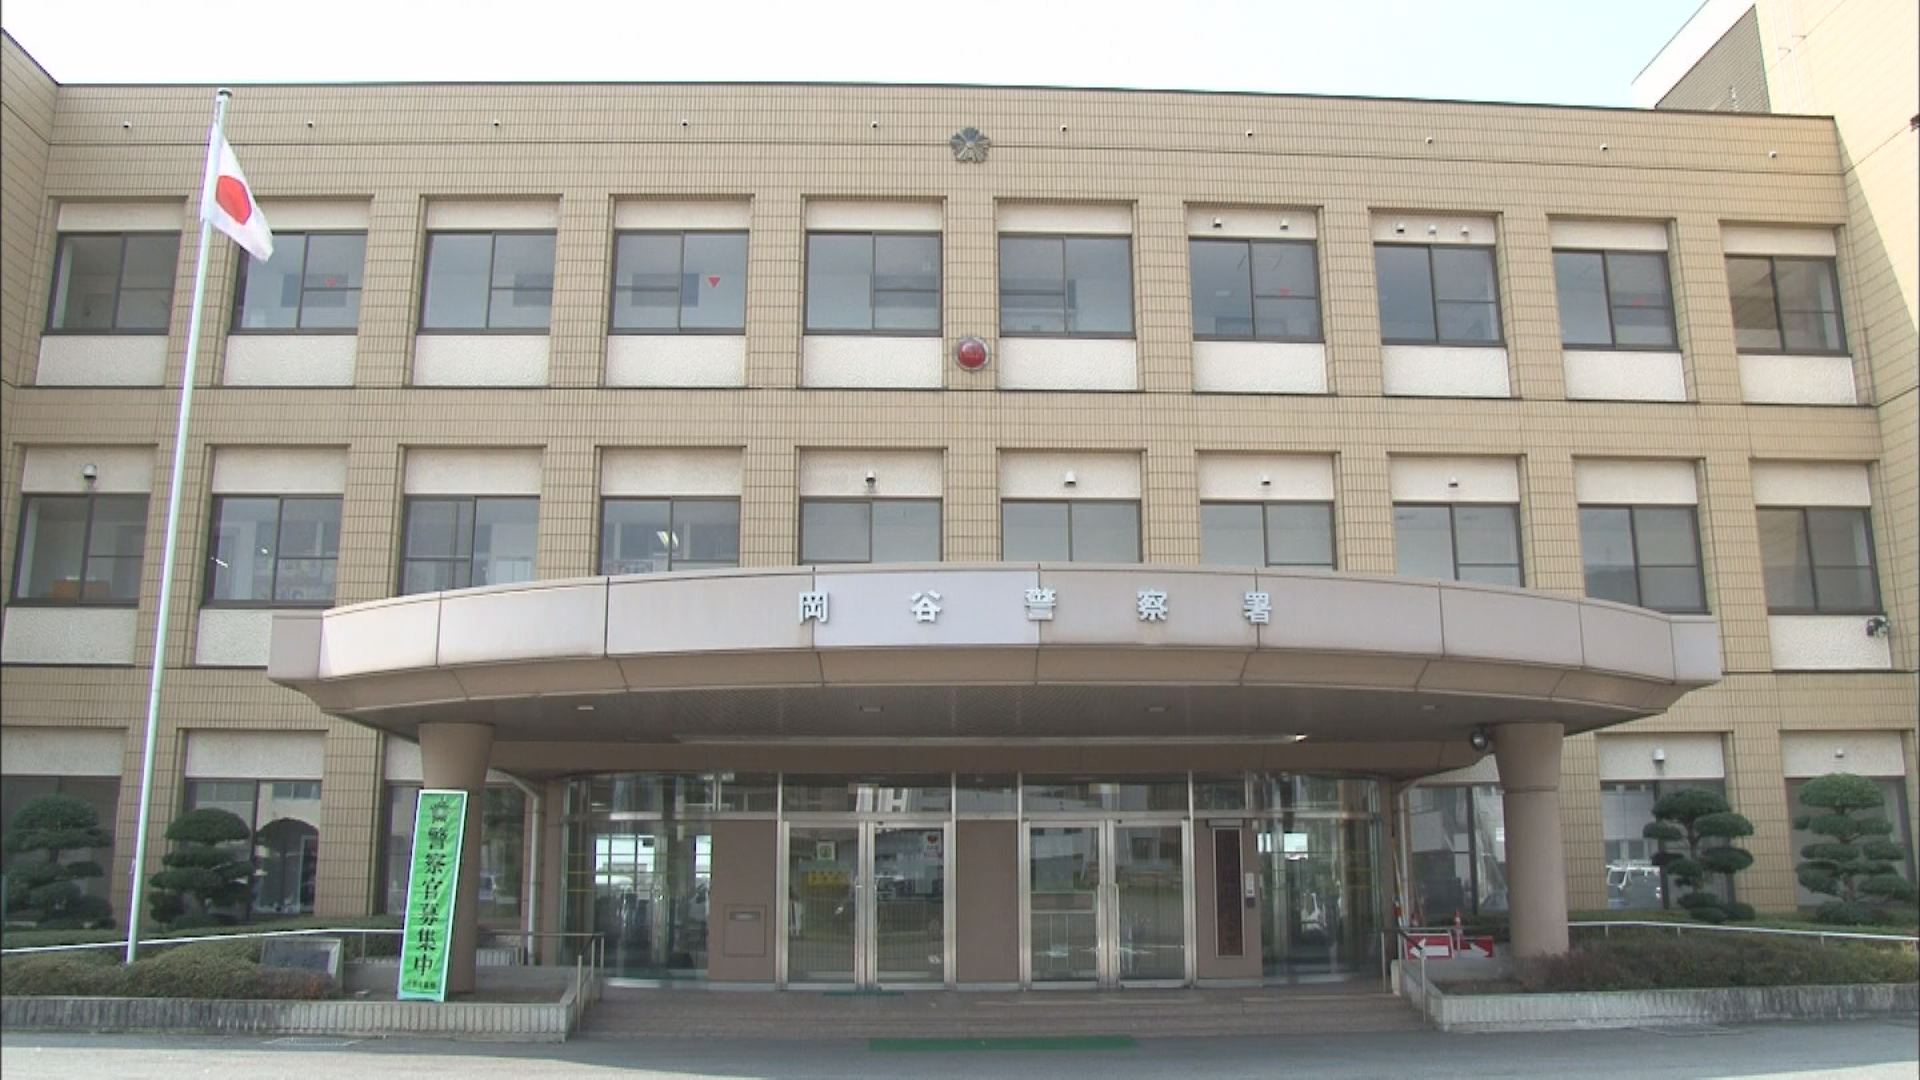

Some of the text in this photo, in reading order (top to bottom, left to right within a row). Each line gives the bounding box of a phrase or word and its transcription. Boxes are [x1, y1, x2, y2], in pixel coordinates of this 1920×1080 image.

[799, 587, 1273, 625] 岡谷警察署
[414, 826, 448, 976] 警察官募集中
